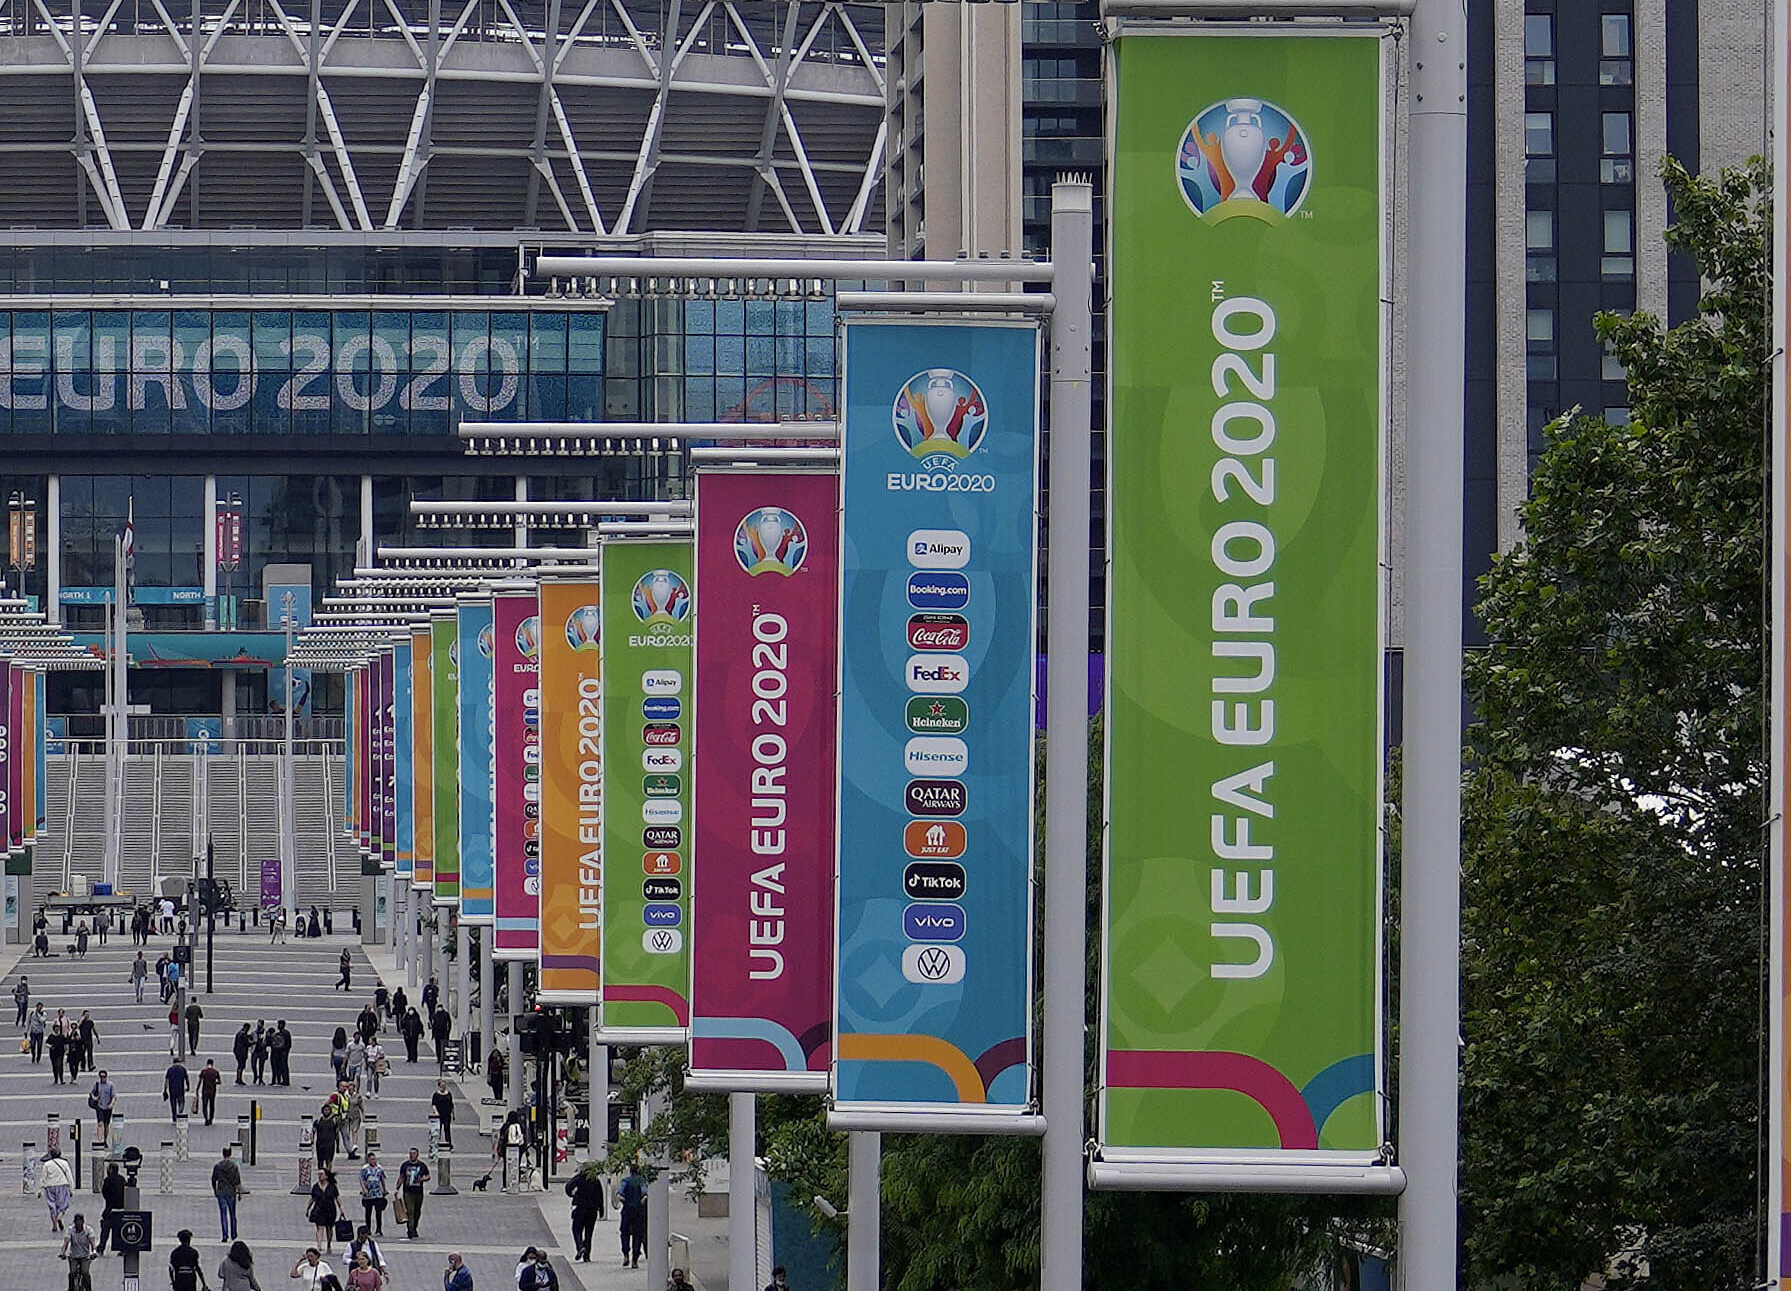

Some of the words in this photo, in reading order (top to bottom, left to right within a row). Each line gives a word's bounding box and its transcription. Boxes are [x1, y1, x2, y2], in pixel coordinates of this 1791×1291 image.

[276, 335, 520, 412] 2020
[1212, 296, 1276, 505] 2020
[922, 457, 958, 470] UEFA
[887, 473, 996, 492] EURO2020
[929, 543, 963, 557] Alipay
[173, 591, 201, 599] NORTH
[910, 584, 967, 597] Booking.com
[1211, 521, 1276, 745] EURO
[752, 613, 788, 726] 2020
[913, 666, 960, 682] FedEx
[912, 717, 961, 728] Heineken
[647, 755, 677, 766] FedEx
[909, 751, 963, 762] Hisense
[751, 733, 787, 855] EURO
[911, 787, 960, 802] QATAR
[579, 760, 601, 844] EURO
[923, 799, 961, 809] AIRWAYS
[647, 830, 678, 841] QATAR
[1210, 760, 1274, 979] UEFA
[579, 849, 601, 929] UEFA
[922, 876, 961, 888] TikTok
[650, 911, 675, 919] vivo
[749, 863, 785, 980] UEFA
[915, 915, 954, 928] vivo
